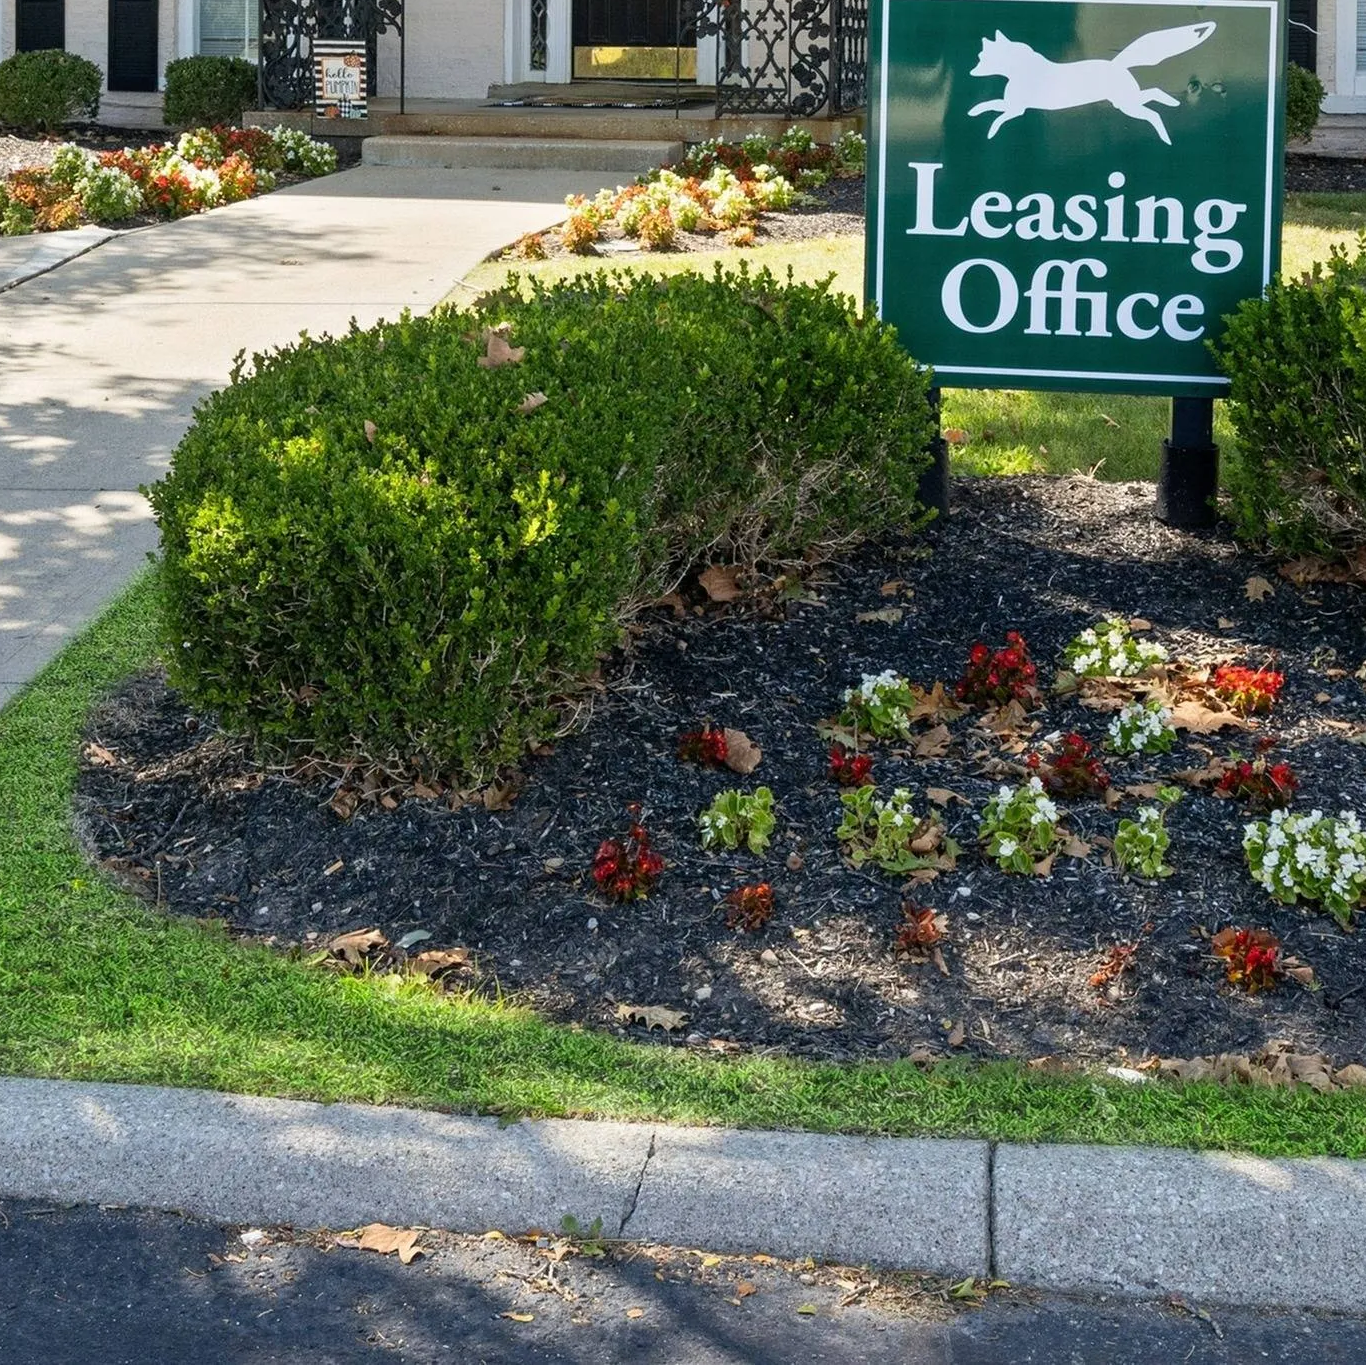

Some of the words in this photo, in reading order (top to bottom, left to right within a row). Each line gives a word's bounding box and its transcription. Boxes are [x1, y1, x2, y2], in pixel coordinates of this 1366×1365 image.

[325, 67, 353, 79] hello
[906, 162, 1247, 274] Leasing
[941, 258, 1205, 342] Office
